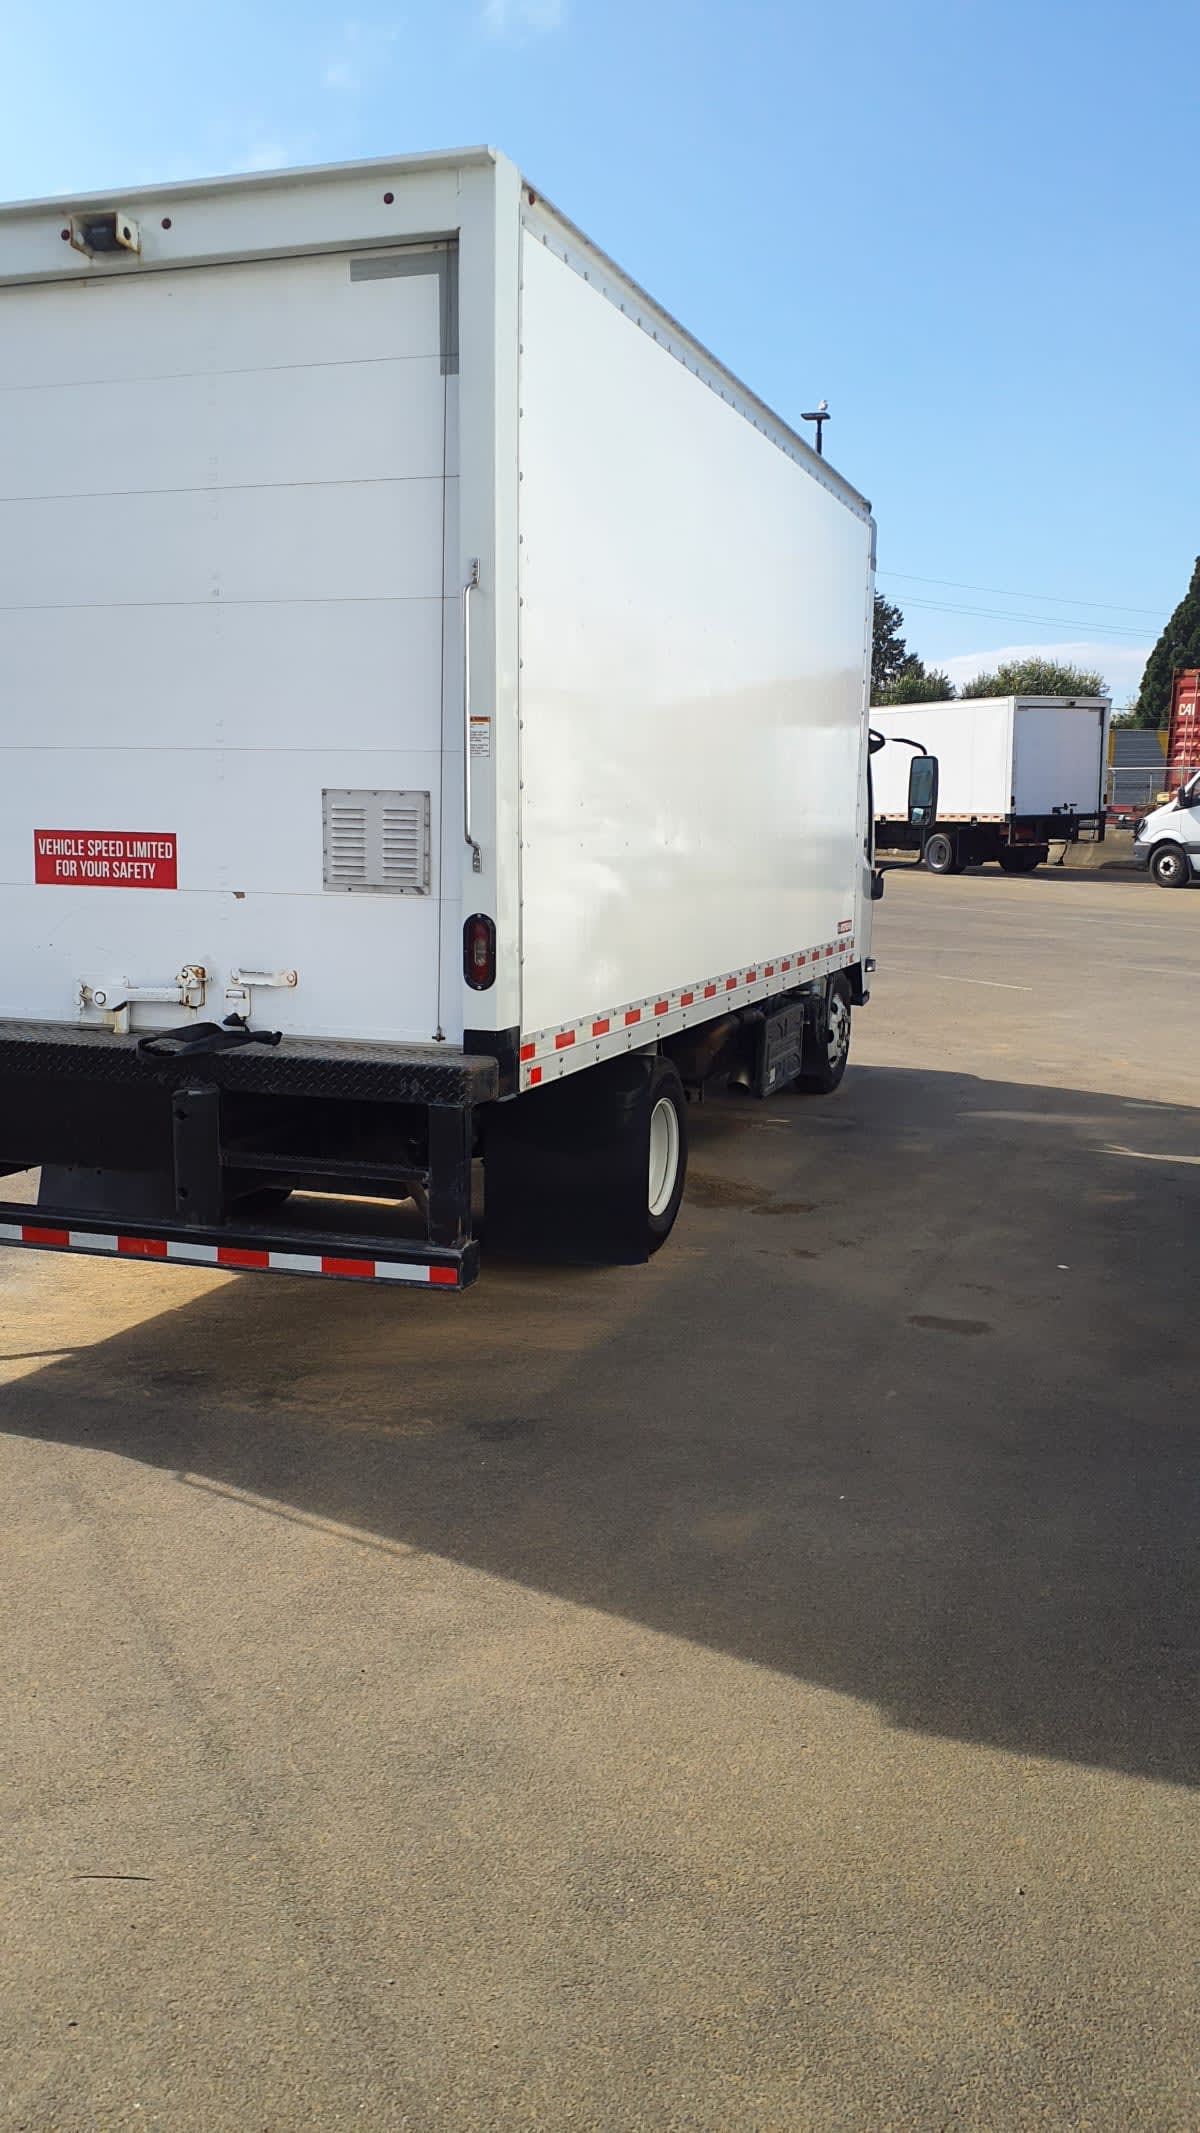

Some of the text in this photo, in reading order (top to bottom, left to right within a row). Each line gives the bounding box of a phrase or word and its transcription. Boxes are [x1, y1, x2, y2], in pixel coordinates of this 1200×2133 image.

[38, 838, 173, 859] VEHICLE SPEED LIMITED
[55, 859, 156, 880] FOR YOUR SAFETY
